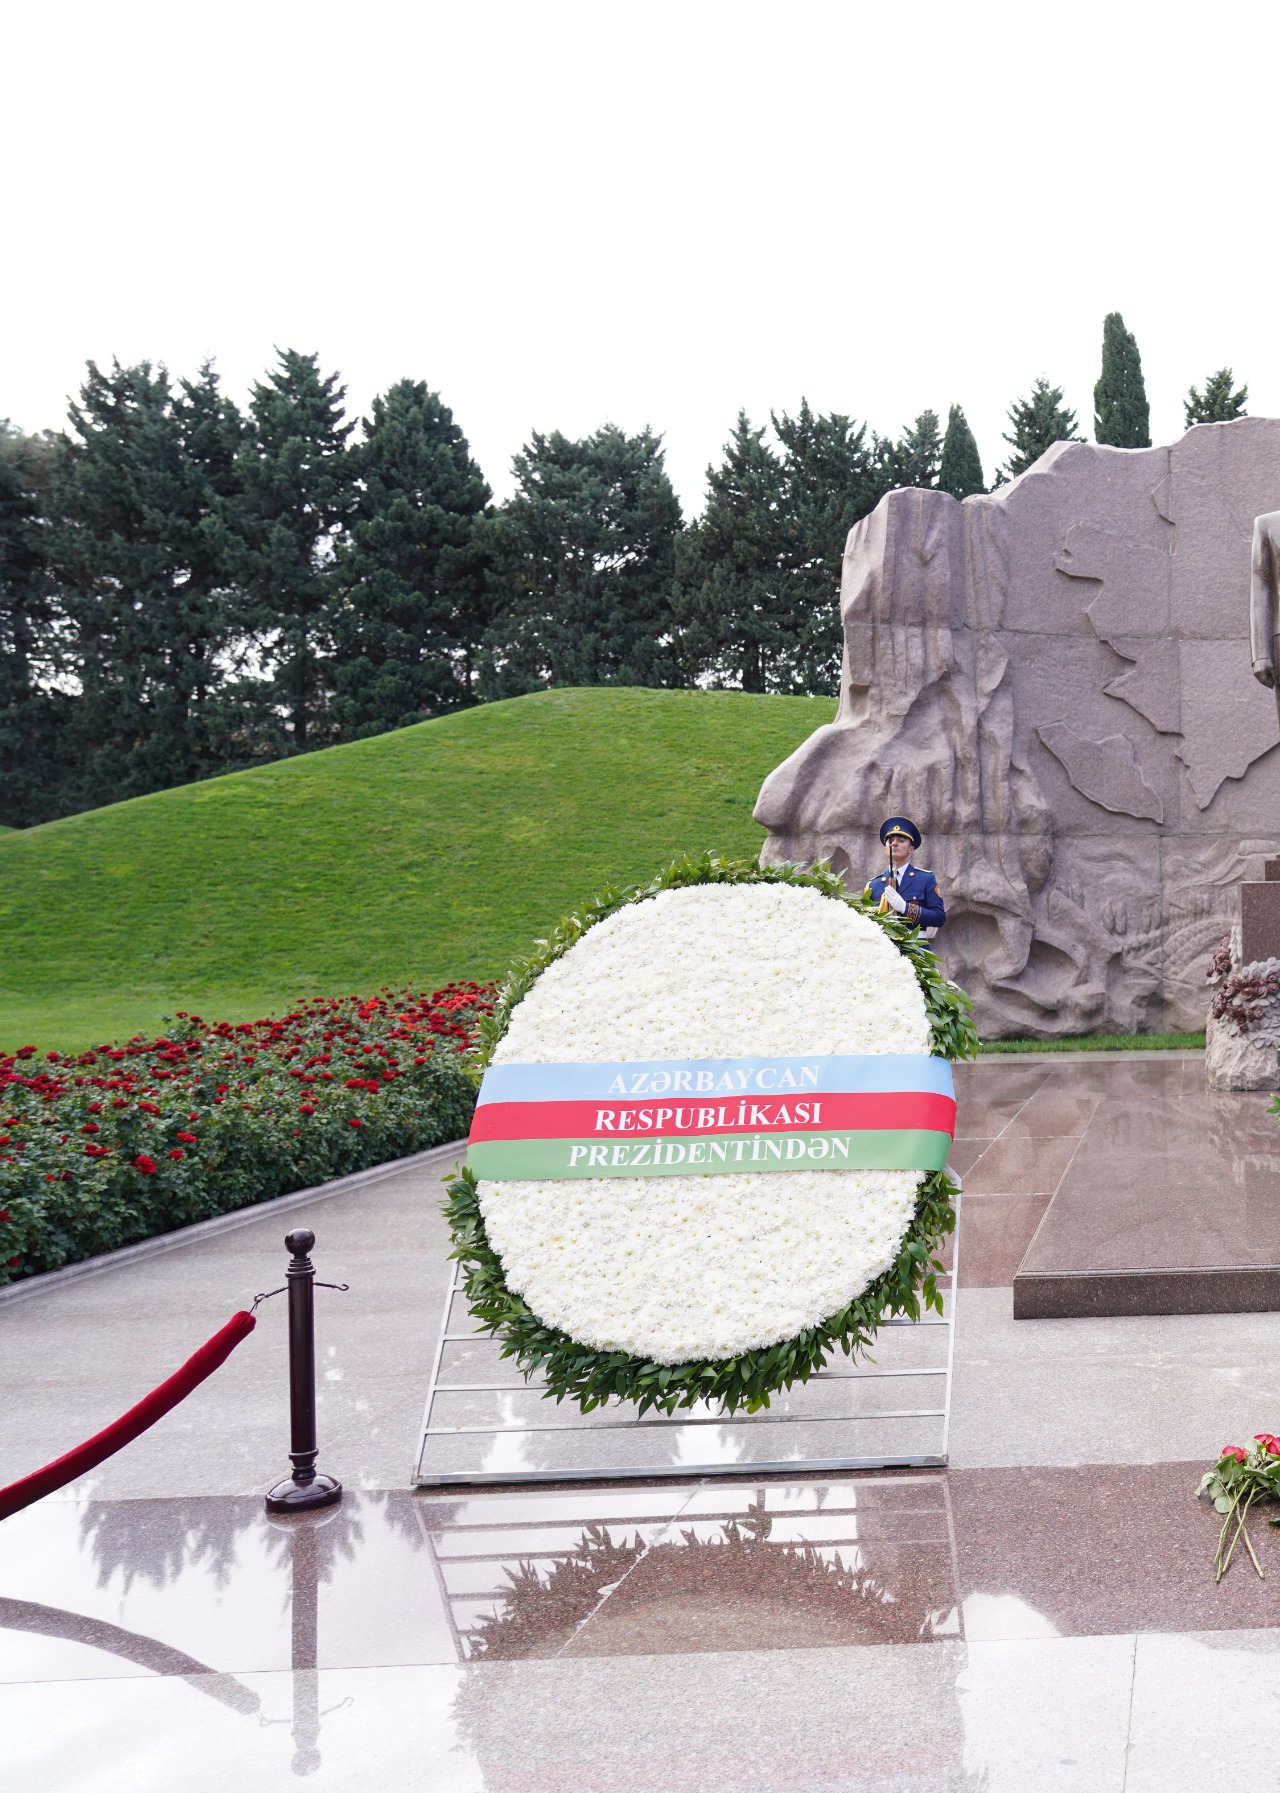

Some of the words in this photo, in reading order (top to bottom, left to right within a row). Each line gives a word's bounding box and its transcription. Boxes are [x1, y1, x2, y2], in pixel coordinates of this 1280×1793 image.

[606, 1065, 821, 1094] AZƏRBAYCAN
[592, 1100, 824, 1131] RESPUBLİKASI
[566, 1134, 852, 1167] PREZİDENTİNDƏN
